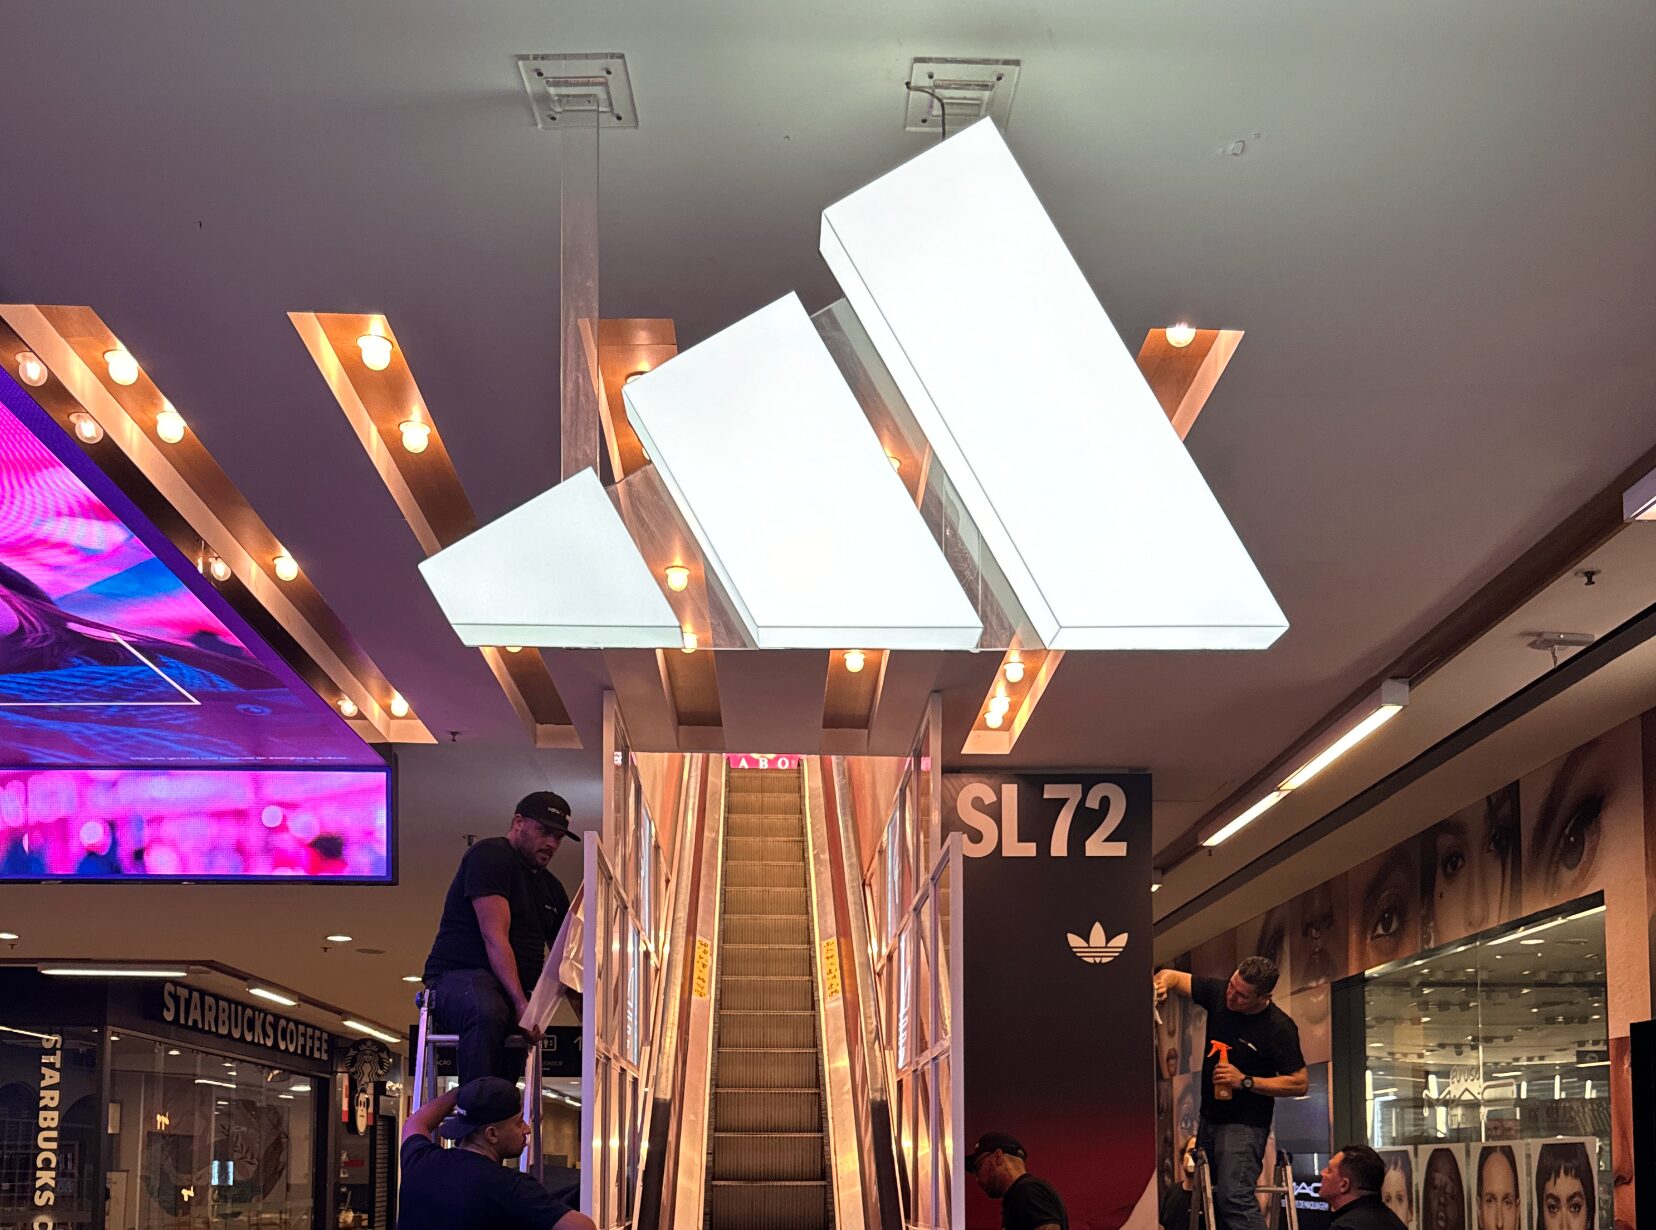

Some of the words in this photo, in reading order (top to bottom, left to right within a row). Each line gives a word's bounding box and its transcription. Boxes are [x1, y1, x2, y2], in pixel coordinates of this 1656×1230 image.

[956, 782, 1037, 858] SL
[1043, 782, 1128, 857] 72
[163, 982, 274, 1047] STARBUCKS
[277, 1018, 329, 1061] COFFEE
[33, 1034, 62, 1207] STARBUCKS
